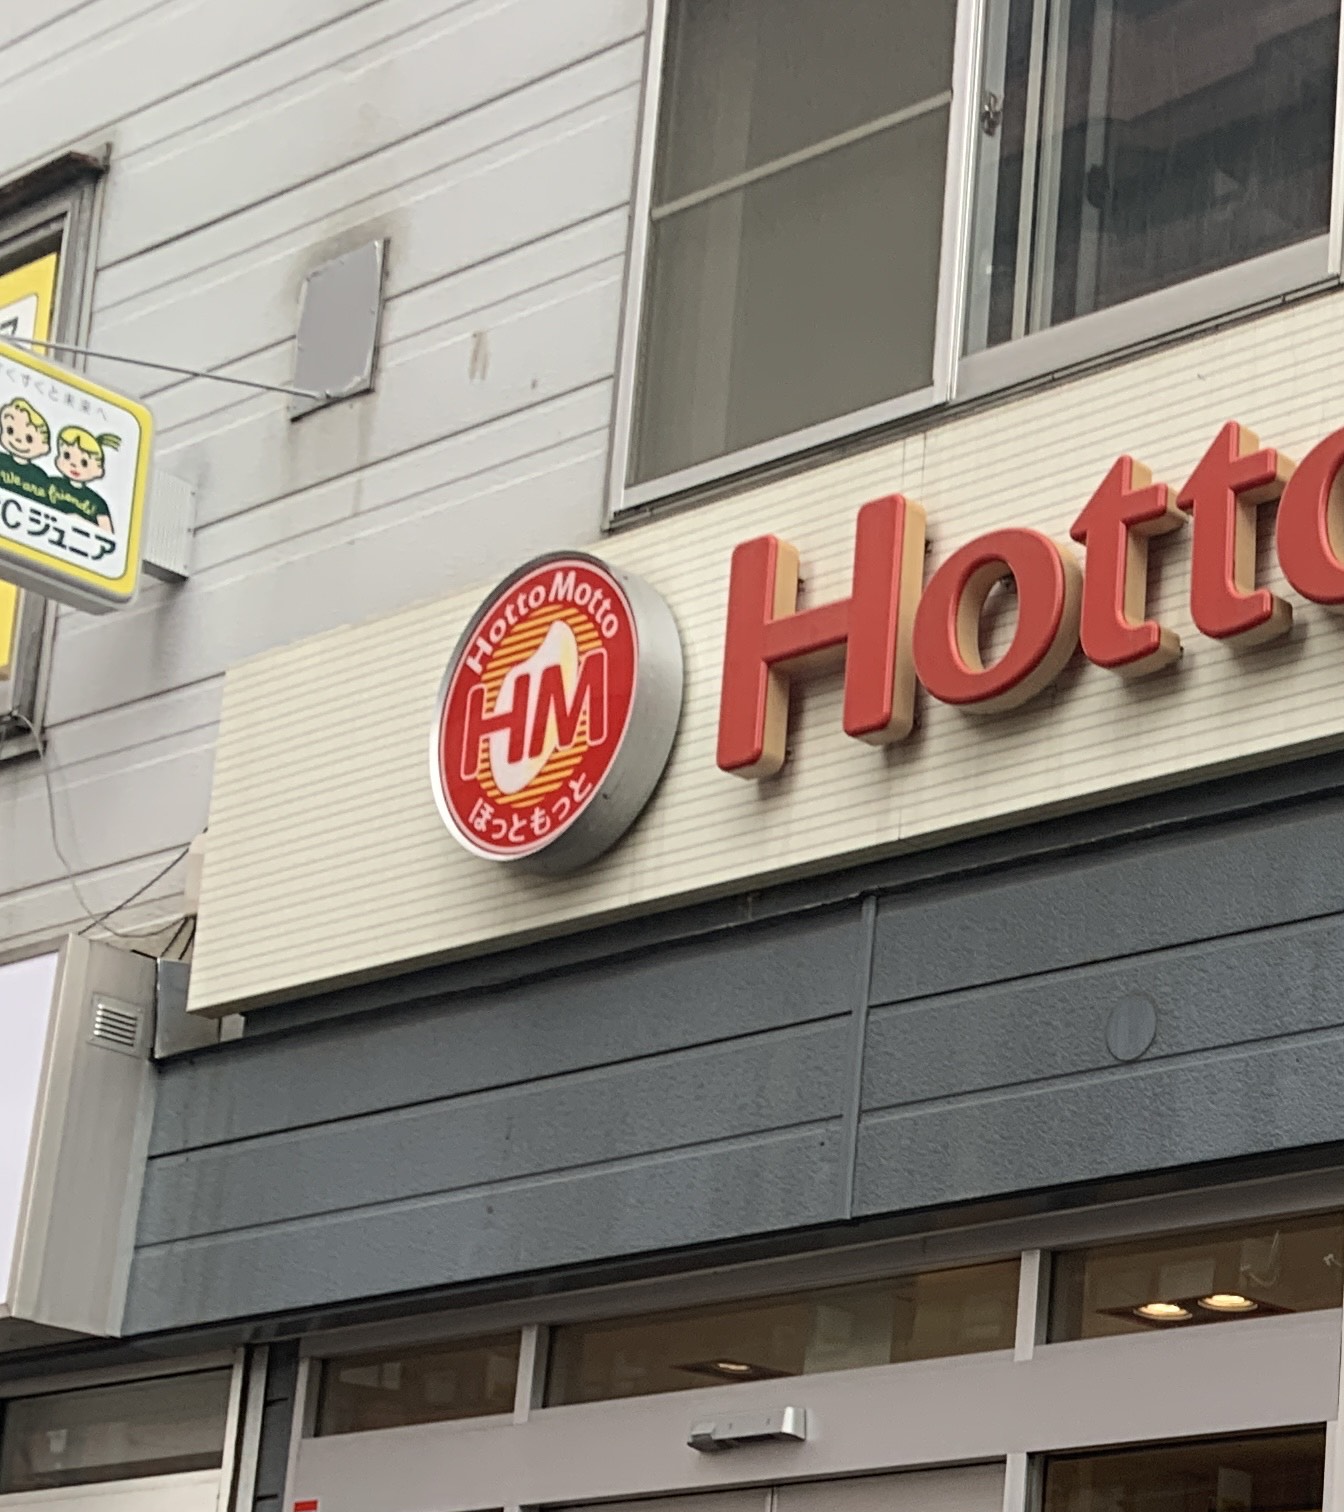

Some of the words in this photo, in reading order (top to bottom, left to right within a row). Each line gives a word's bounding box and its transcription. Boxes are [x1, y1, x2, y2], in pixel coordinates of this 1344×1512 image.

[469, 773, 592, 842] ほっともっと
